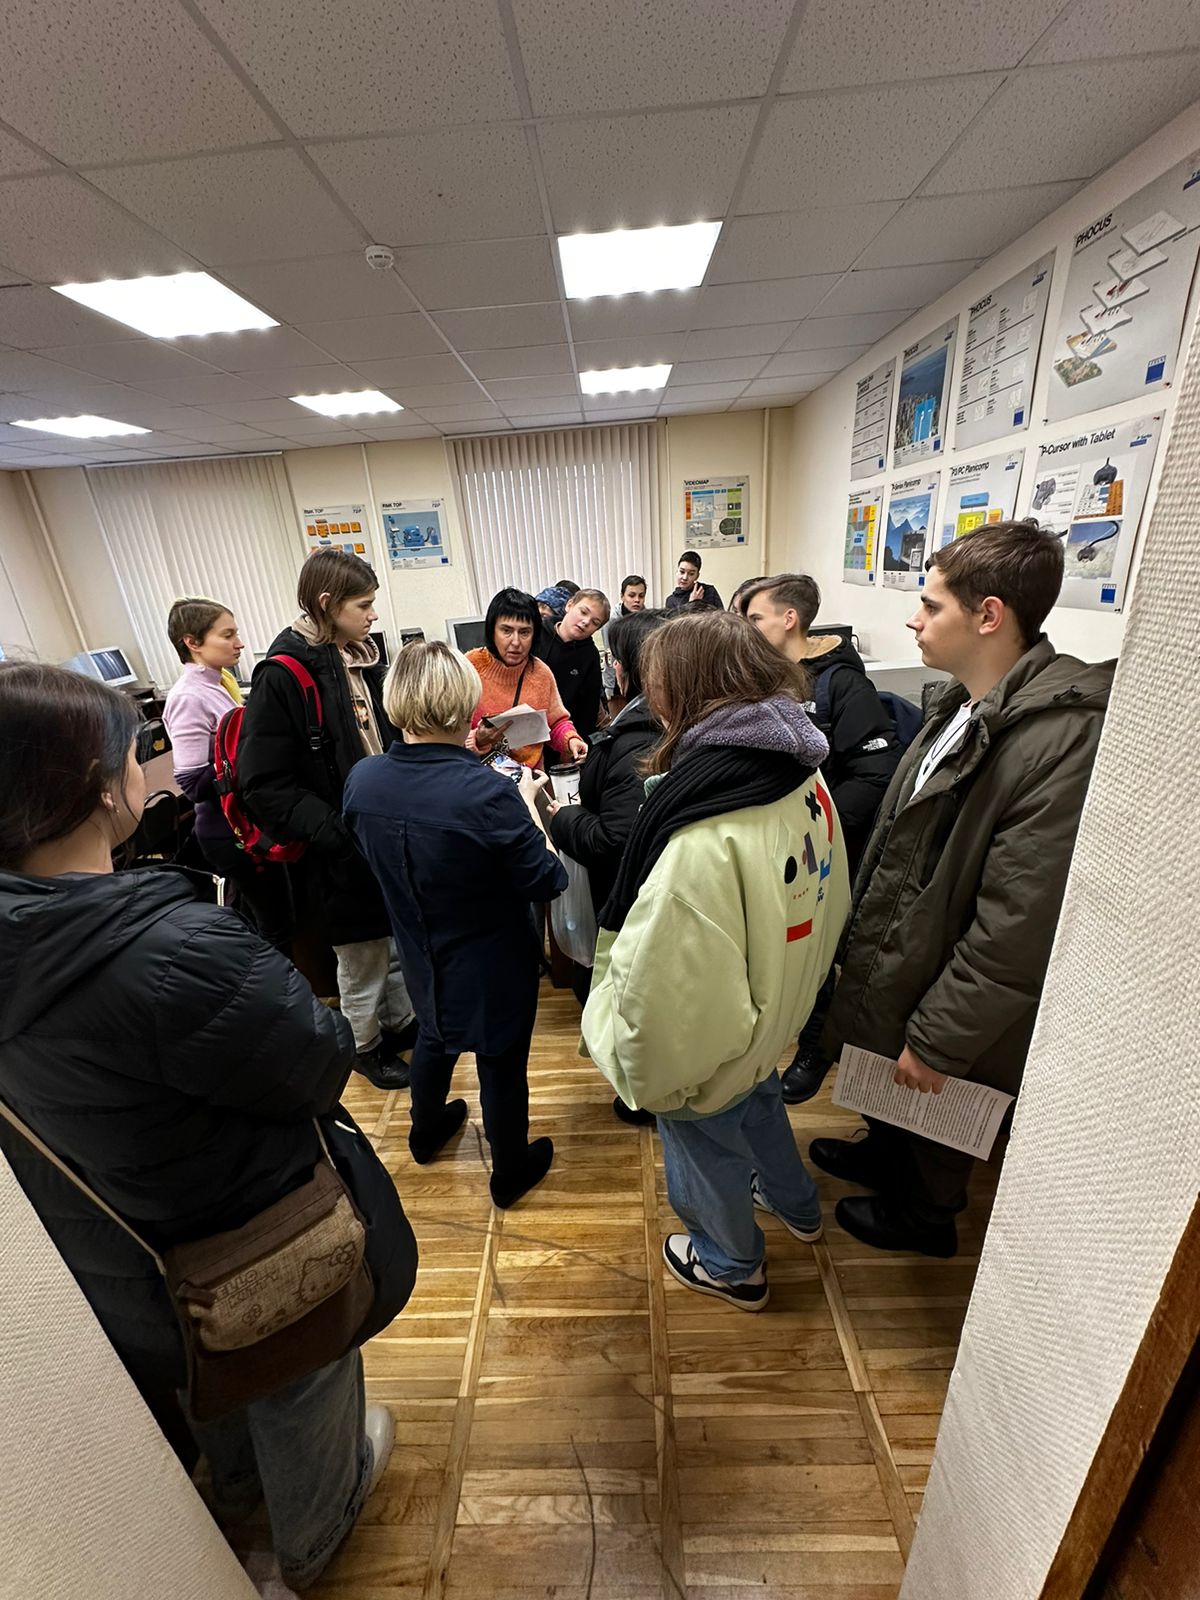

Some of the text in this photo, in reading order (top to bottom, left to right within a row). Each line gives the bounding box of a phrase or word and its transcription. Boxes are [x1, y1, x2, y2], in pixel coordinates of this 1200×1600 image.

[1075, 213, 1113, 248] PHOCUS
[1040, 428, 1116, 457] P-Cursor with Tablet
[965, 461, 990, 474] Planicomp
